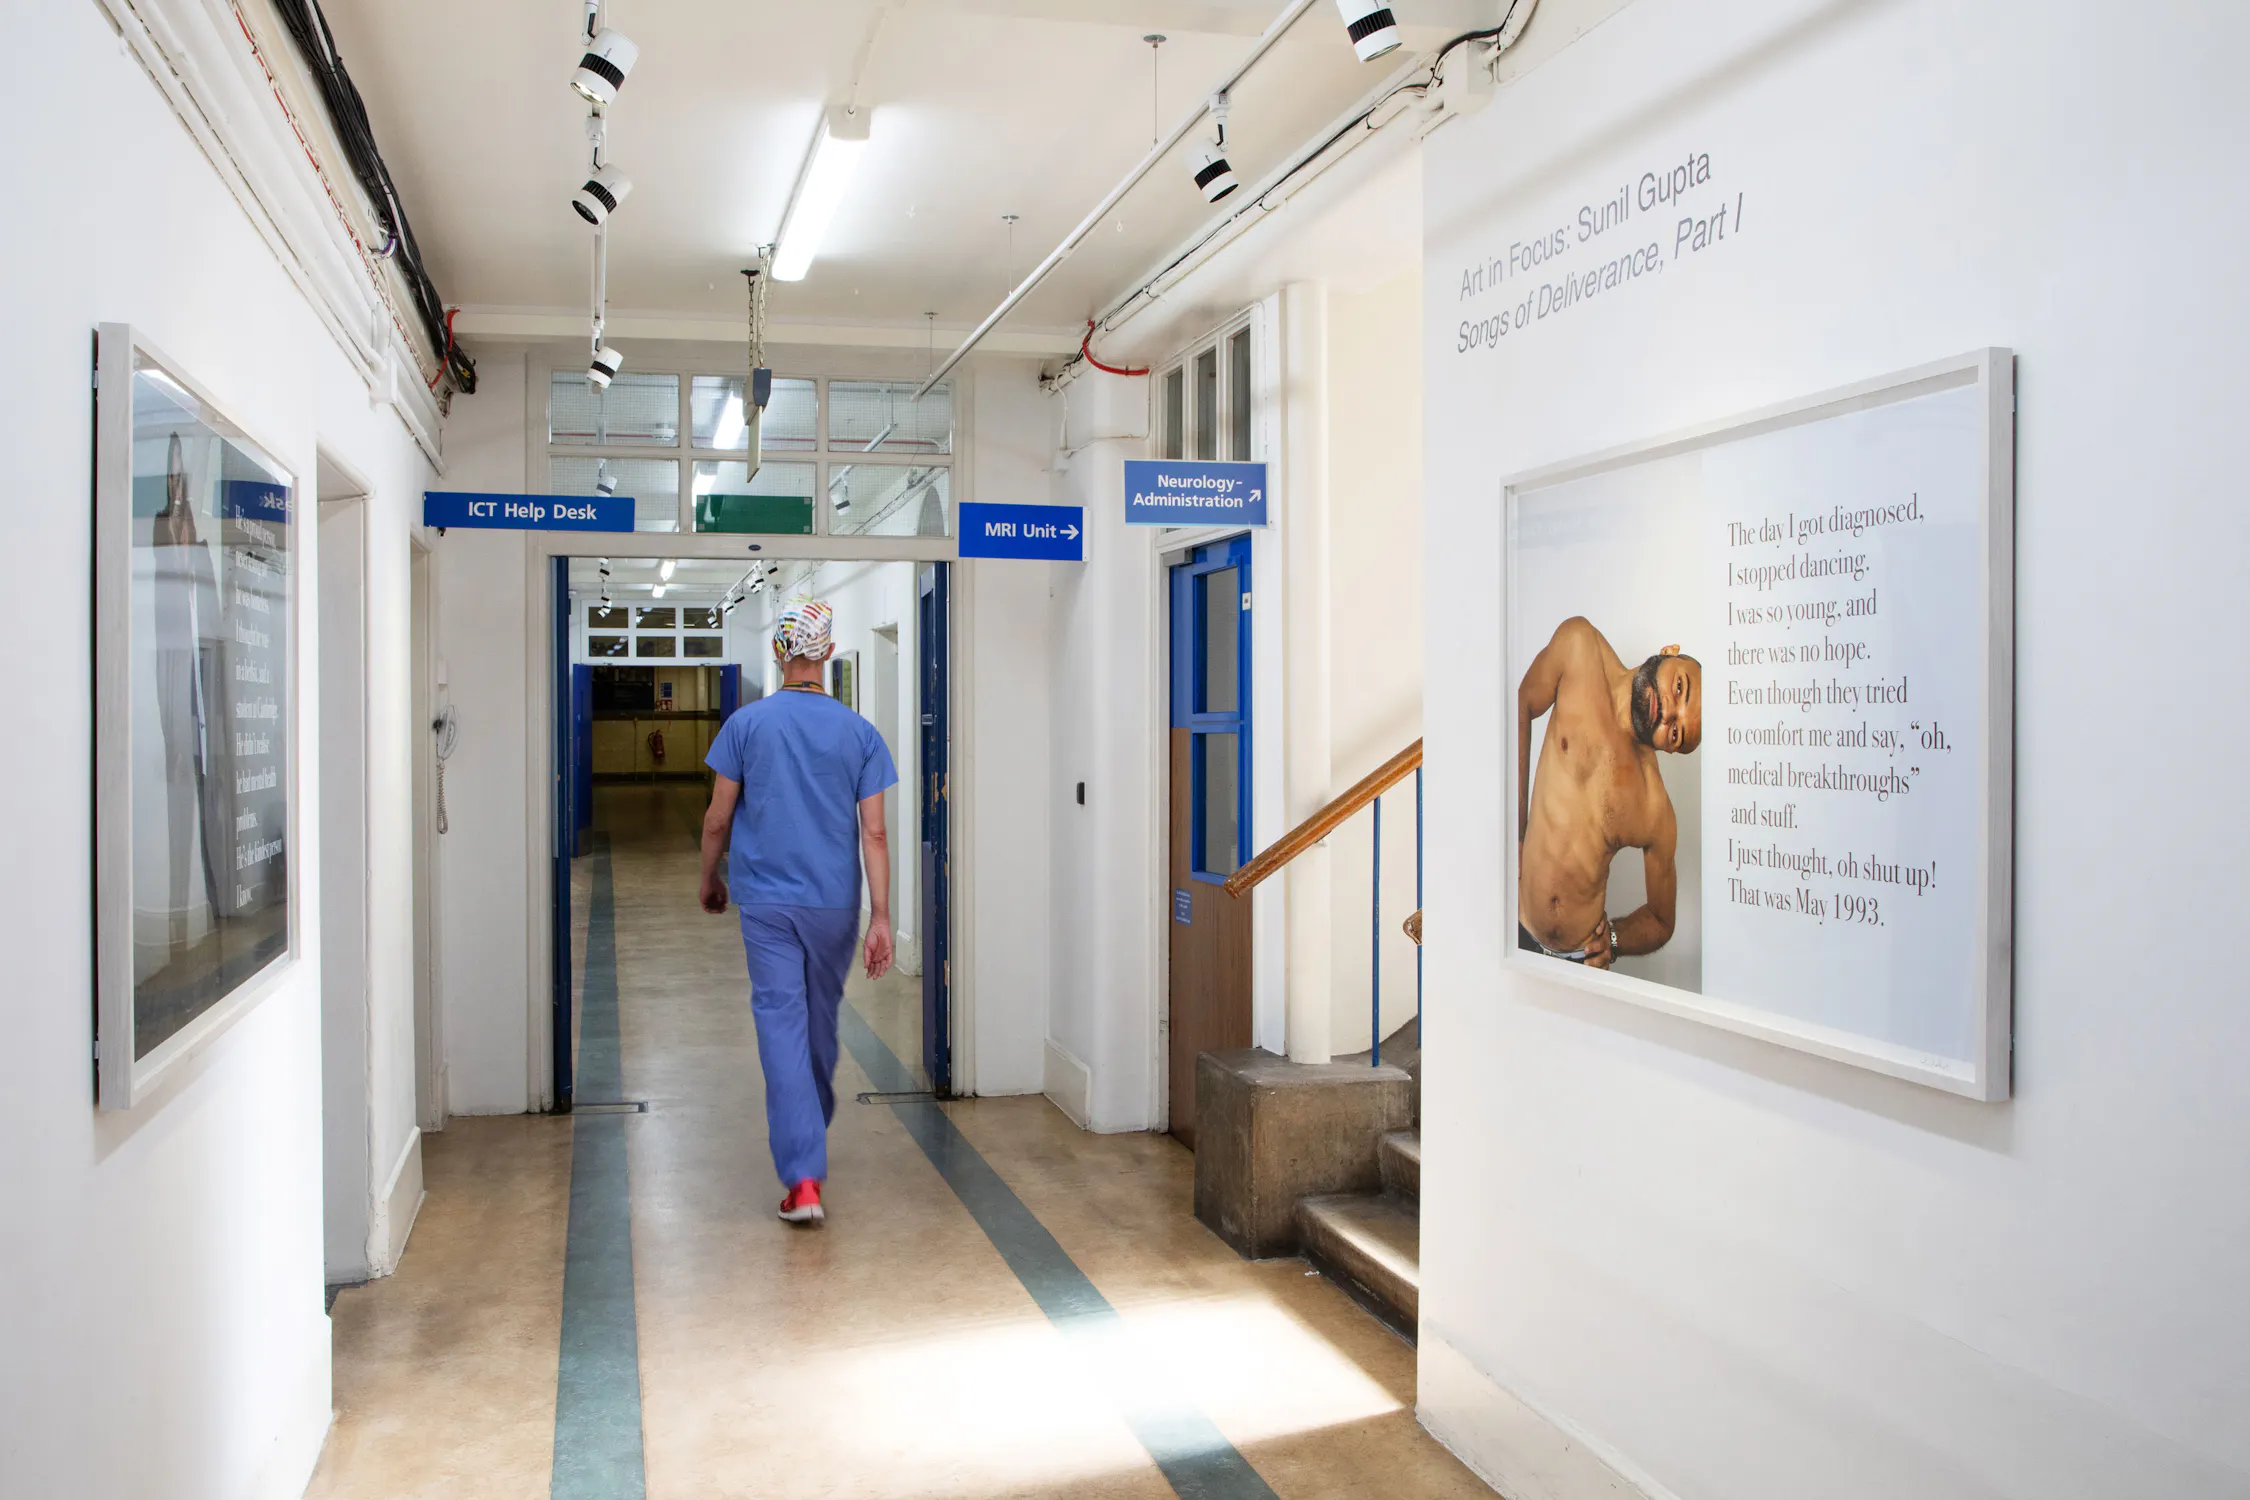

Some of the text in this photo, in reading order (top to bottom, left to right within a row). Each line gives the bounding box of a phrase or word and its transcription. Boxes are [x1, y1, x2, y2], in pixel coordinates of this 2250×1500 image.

[1460, 152, 1712, 301] Art in Focus: Sunil Gupta
[1457, 192, 1744, 353] Songs of Deliverance, Part I
[468, 501, 597, 521] ICT Help Desk
[1132, 492, 1243, 508] Administration
[985, 522, 1056, 539] MRI Unit
[1728, 491, 1924, 549] The day I got diagnosed,
[1728, 549, 1870, 591] I stopped dancing.
[1728, 588, 1877, 630] I was so young, and
[1728, 635, 1871, 669] there was no hope.
[1728, 676, 1908, 713] Even though they tried
[1728, 726, 1742, 745] to
[1745, 720, 1804, 746] comfort
[1809, 730, 1832, 747] me
[1837, 721, 1867, 748] and
[1871, 728, 1905, 757] say,
[1728, 761, 1783, 787] medical
[1731, 801, 1798, 829] and stuff.
[1728, 838, 1937, 896] I just thought, oh shut up!
[1728, 878, 1884, 927] That was May 1993.
